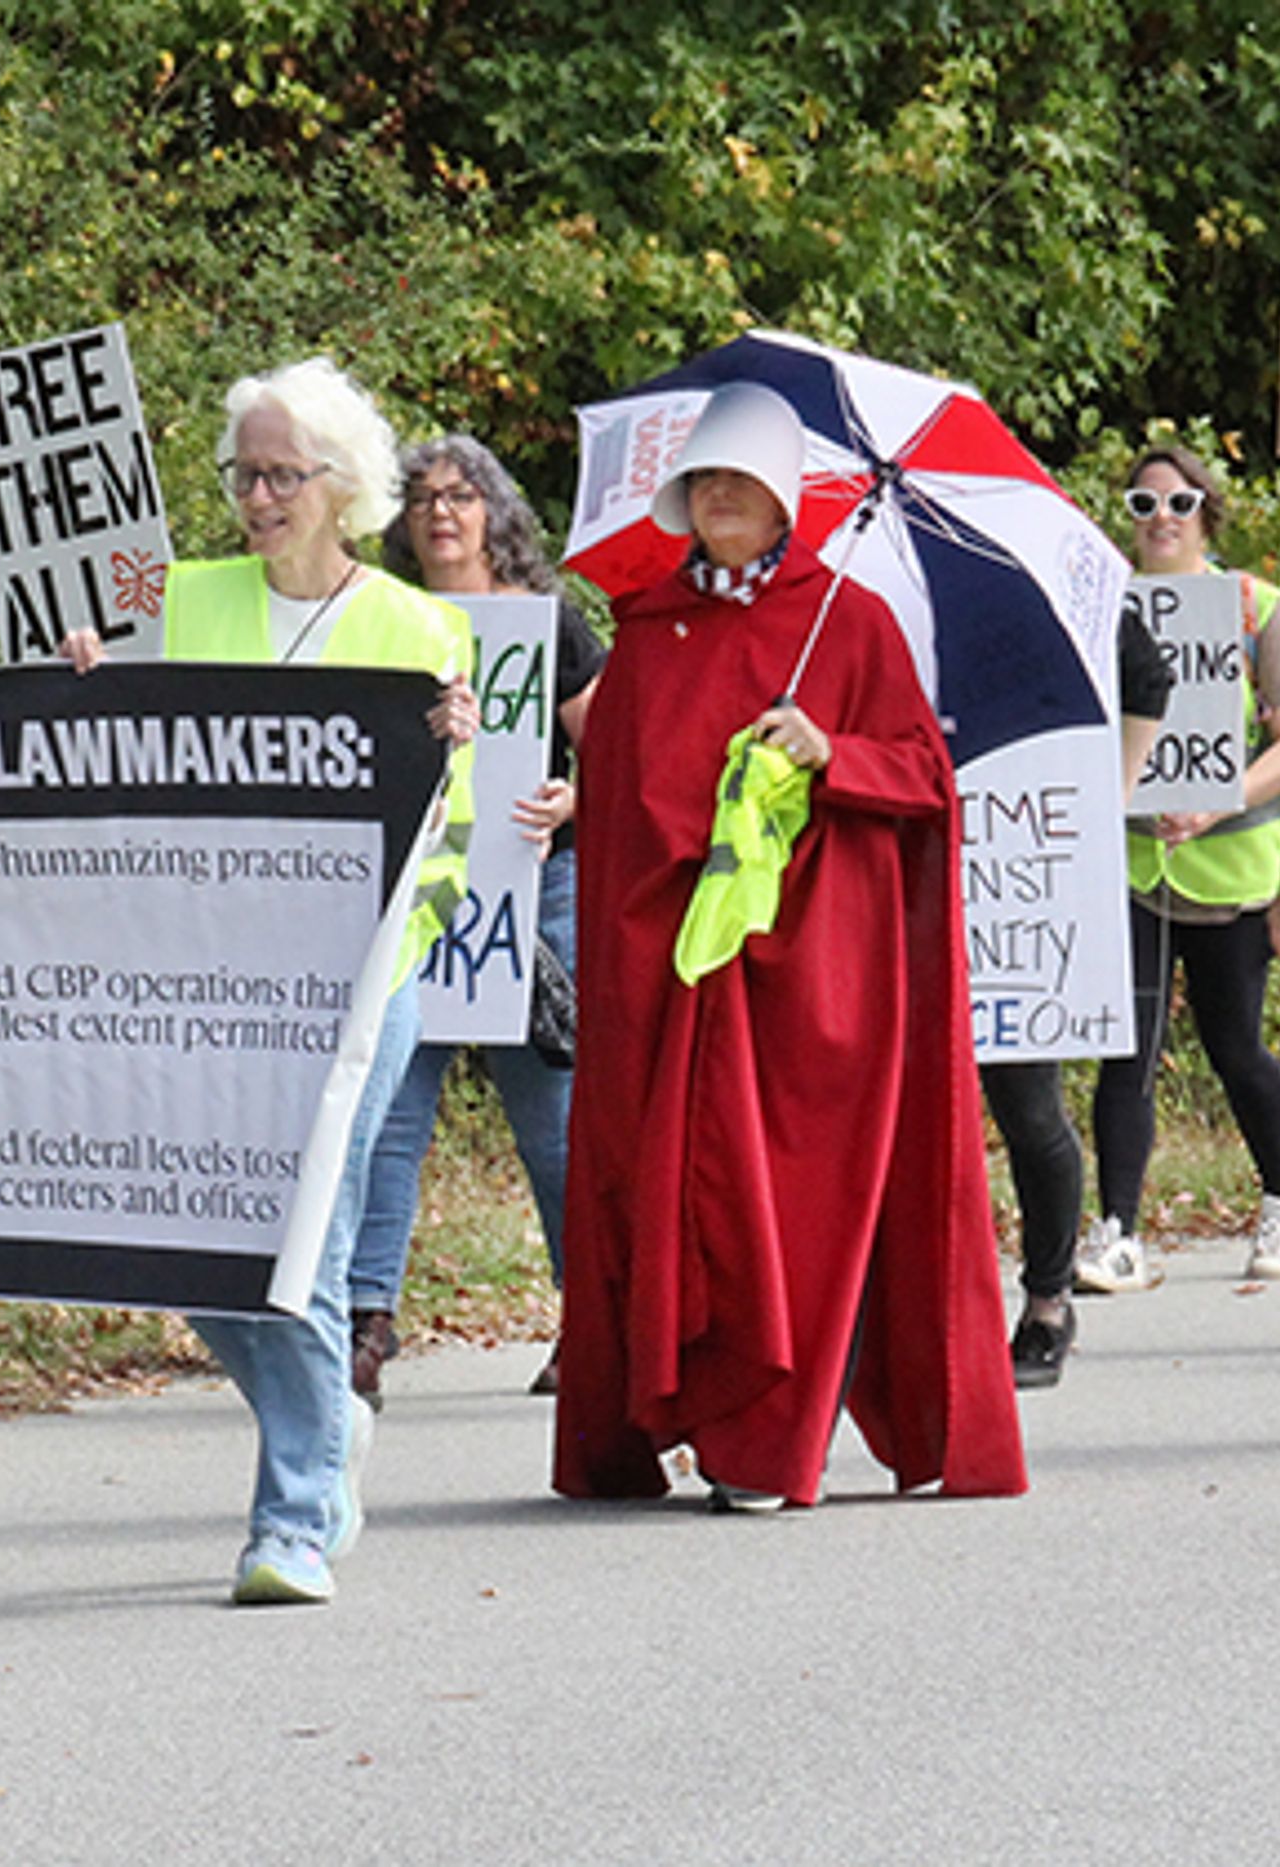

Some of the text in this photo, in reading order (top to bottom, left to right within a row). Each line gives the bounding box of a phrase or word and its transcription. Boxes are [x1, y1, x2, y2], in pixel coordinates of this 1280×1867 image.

[4, 556, 135, 663] ALL
[472, 636, 545, 740] GA
[218, 842, 371, 884] practices
[966, 852, 1073, 904] NST
[970, 919, 1077, 995] NITY
[26, 964, 99, 1000] CBP
[106, 967, 287, 1007] operations
[296, 973, 353, 1011] that
[70, 1012, 174, 1047] extent
[182, 1013, 341, 1054] permitted
[1026, 999, 1120, 1048] Out
[27, 1128, 141, 1171] federal
[149, 1136, 237, 1177] levels
[243, 1146, 272, 1179] to
[276, 1149, 301, 1182] st
[120, 1179, 179, 1216] and
[186, 1182, 282, 1225] offices
